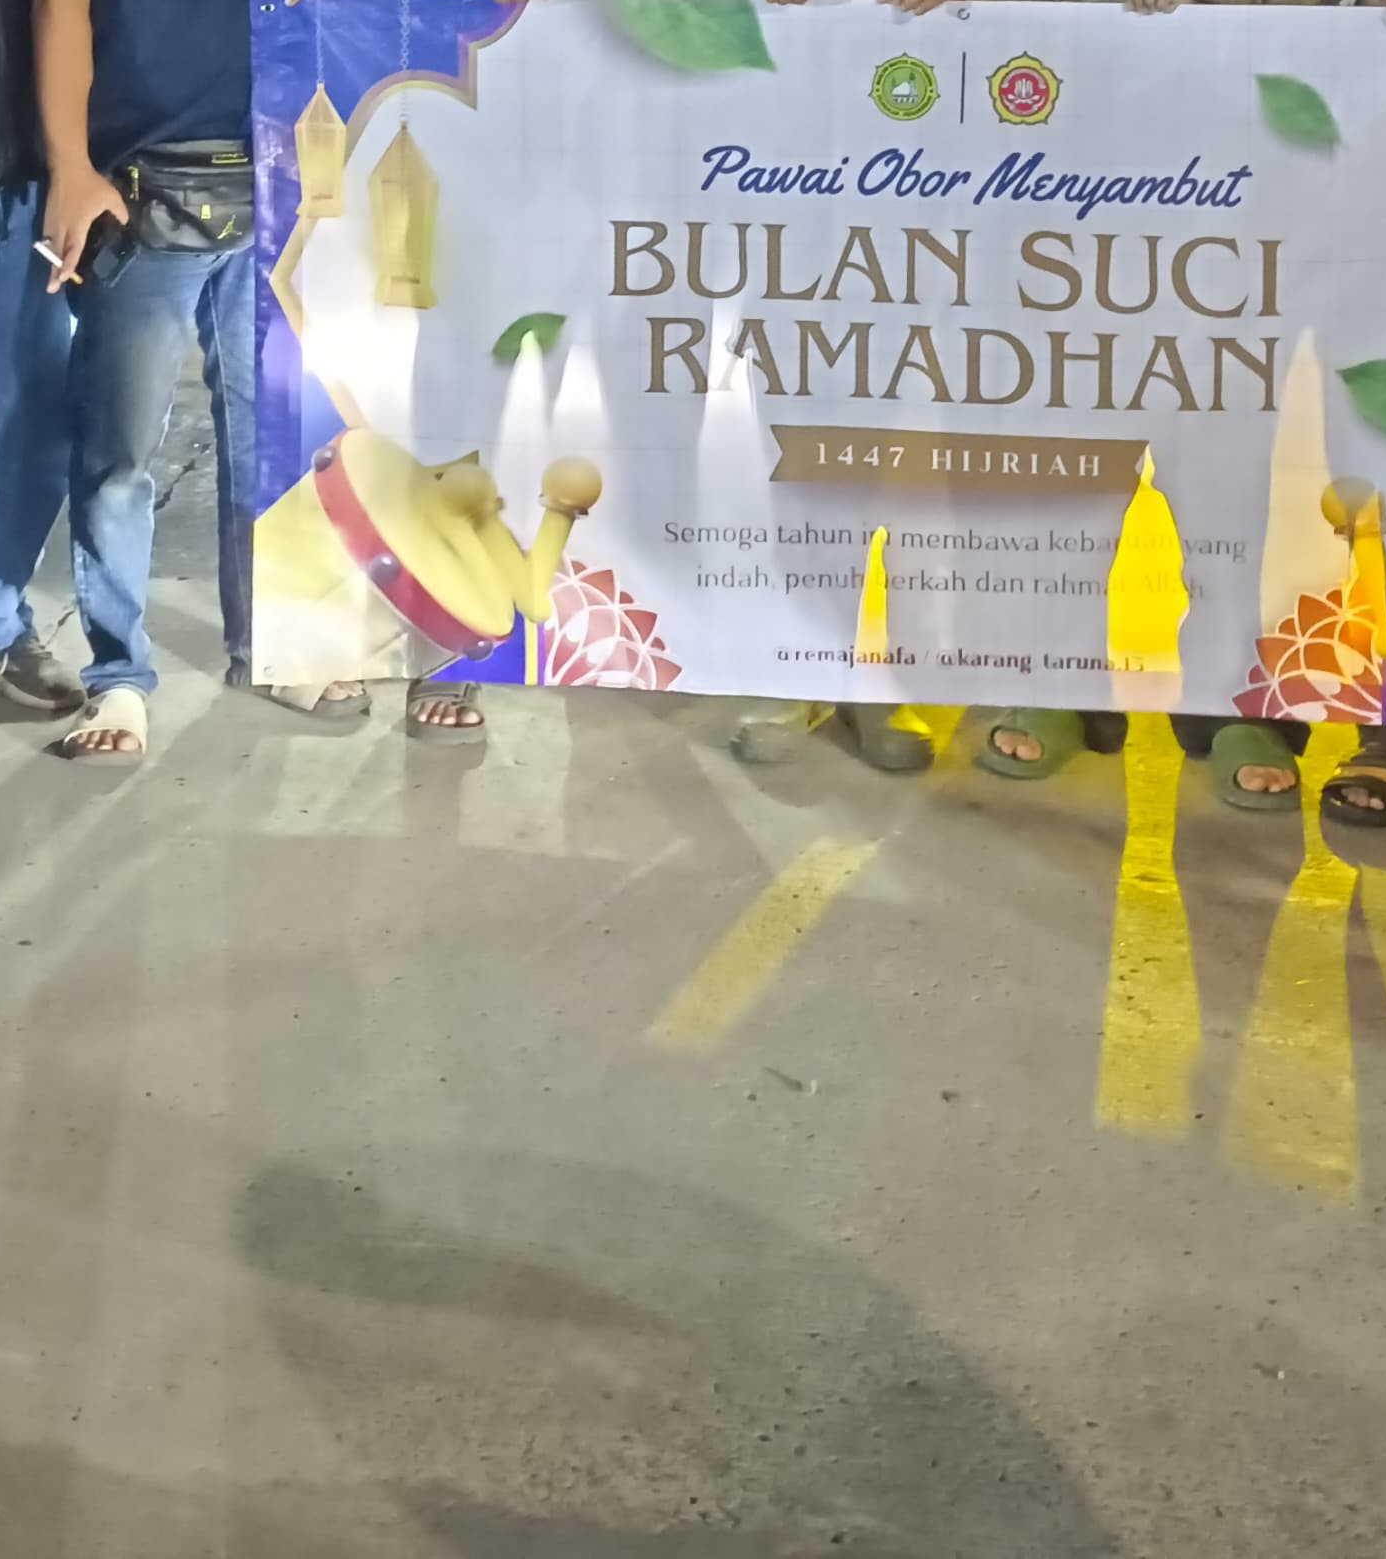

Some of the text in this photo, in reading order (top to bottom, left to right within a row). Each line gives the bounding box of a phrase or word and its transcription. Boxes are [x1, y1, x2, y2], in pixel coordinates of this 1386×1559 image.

[701, 144, 1253, 220] Pawai Obor Menyambut
[608, 220, 1283, 319] BULAN SUCI
[644, 317, 1281, 412] RAMADHAN
[816, 442, 1100, 477] 1447 HIJRIAH
[664, 521, 767, 550] Semoga
[778, 523, 852, 545] tahun
[901, 529, 1039, 551] membawa
[1184, 538, 1246, 563] yang
[786, 568, 866, 594] penuh
[975, 570, 1024, 593] dan
